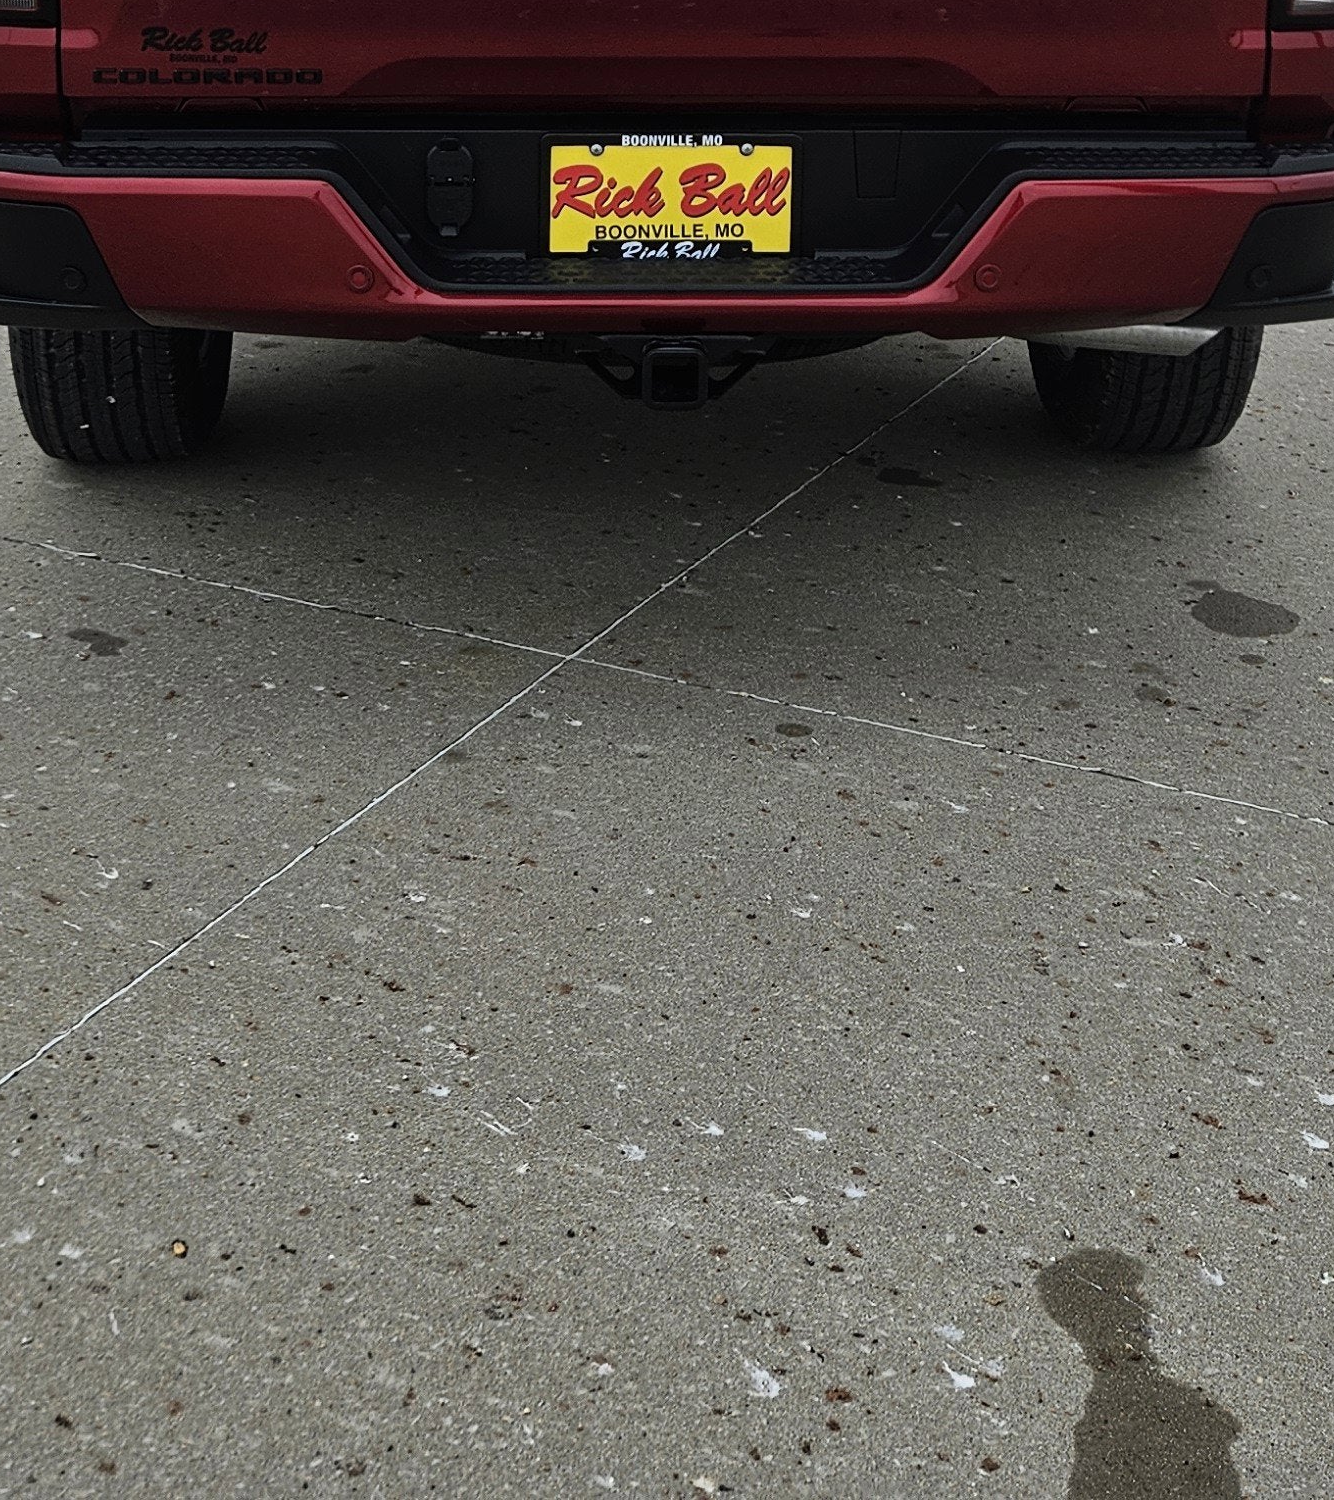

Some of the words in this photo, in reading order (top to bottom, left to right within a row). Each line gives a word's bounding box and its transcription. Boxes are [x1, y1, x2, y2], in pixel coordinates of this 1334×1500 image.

[140, 26, 203, 51] Rick
[208, 28, 268, 54] Ball
[92, 67, 323, 85] COLORADO
[621, 134, 698, 147] BOONVILLE,
[701, 134, 723, 146] MO
[552, 164, 666, 219] Rick
[678, 162, 791, 218] Ball
[595, 224, 709, 240] BOONVILLE,
[715, 223, 744, 237] MO
